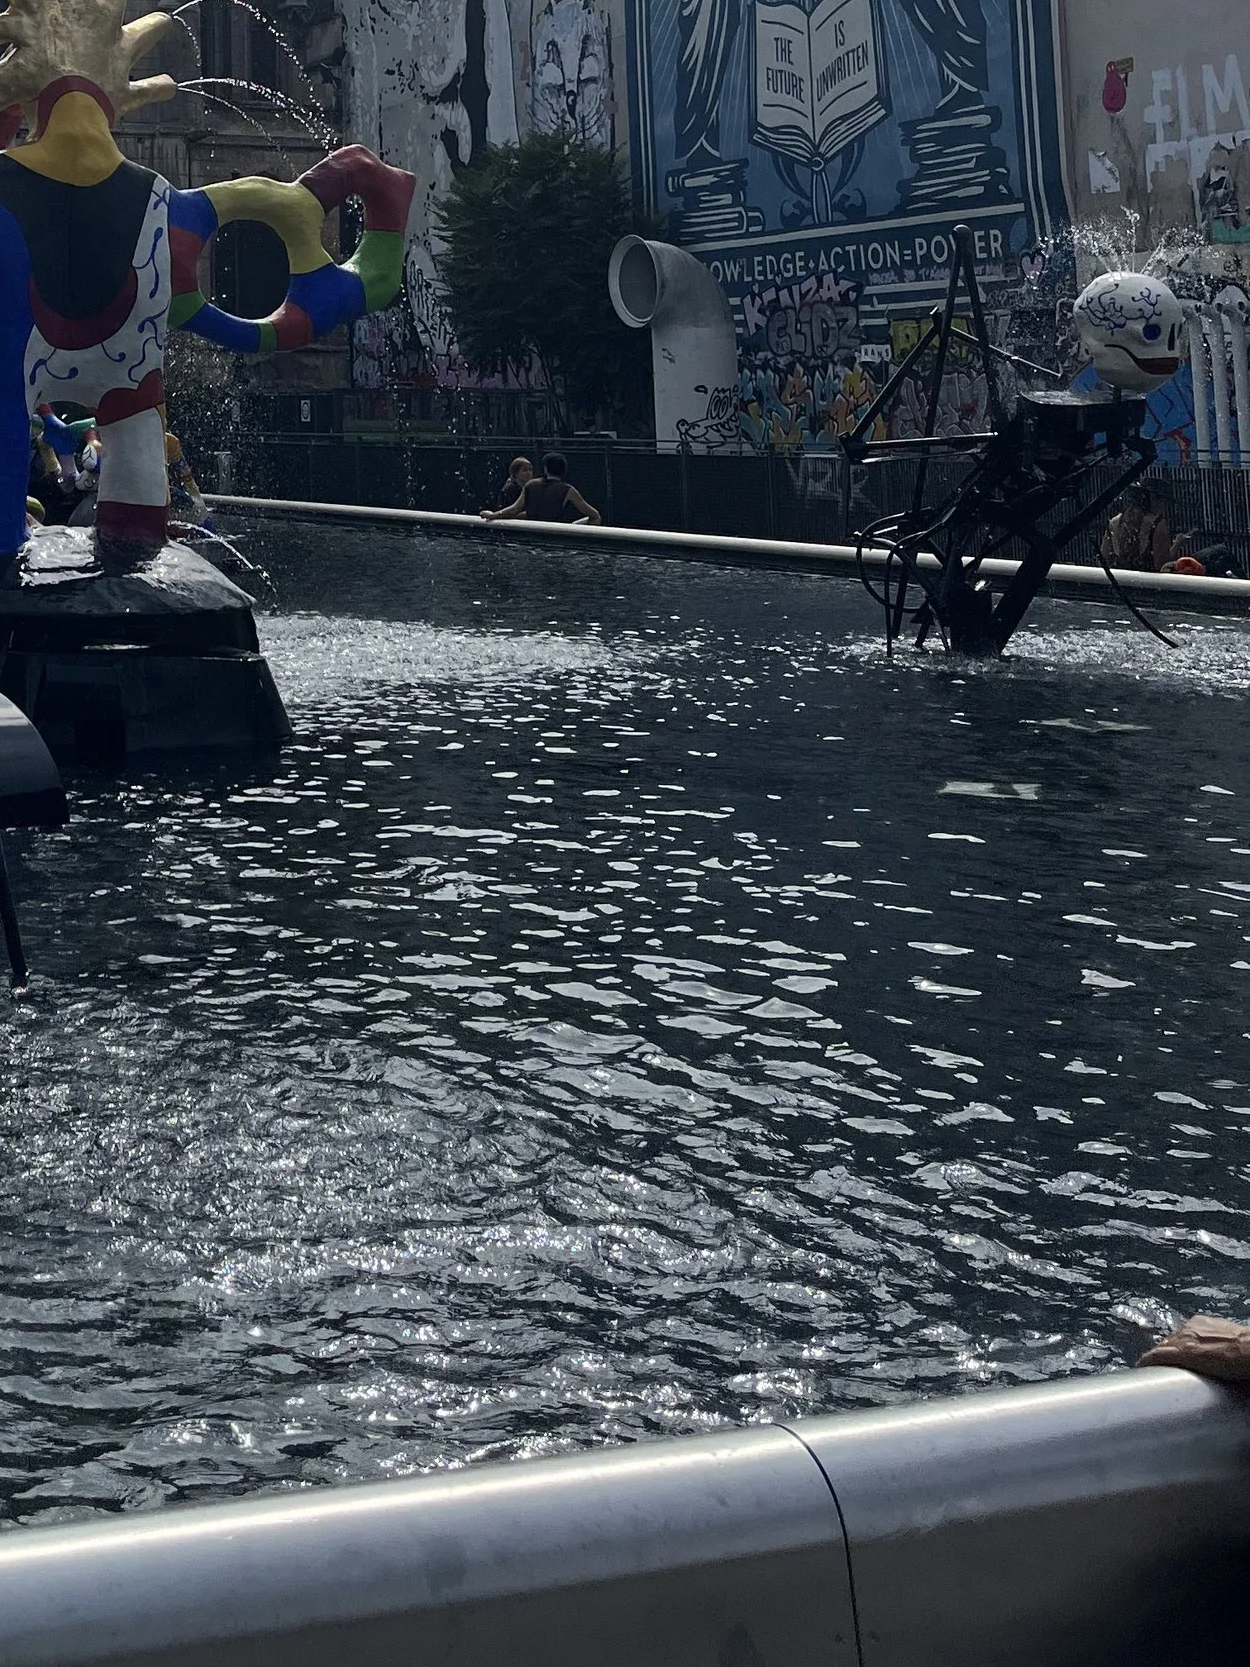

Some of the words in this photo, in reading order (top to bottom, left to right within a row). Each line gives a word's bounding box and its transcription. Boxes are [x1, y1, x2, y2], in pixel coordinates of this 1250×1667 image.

[834, 19, 845, 49] IS
[774, 37, 794, 66] THE
[766, 66, 805, 104] FUTURE
[816, 40, 869, 102] UNWRITTEN
